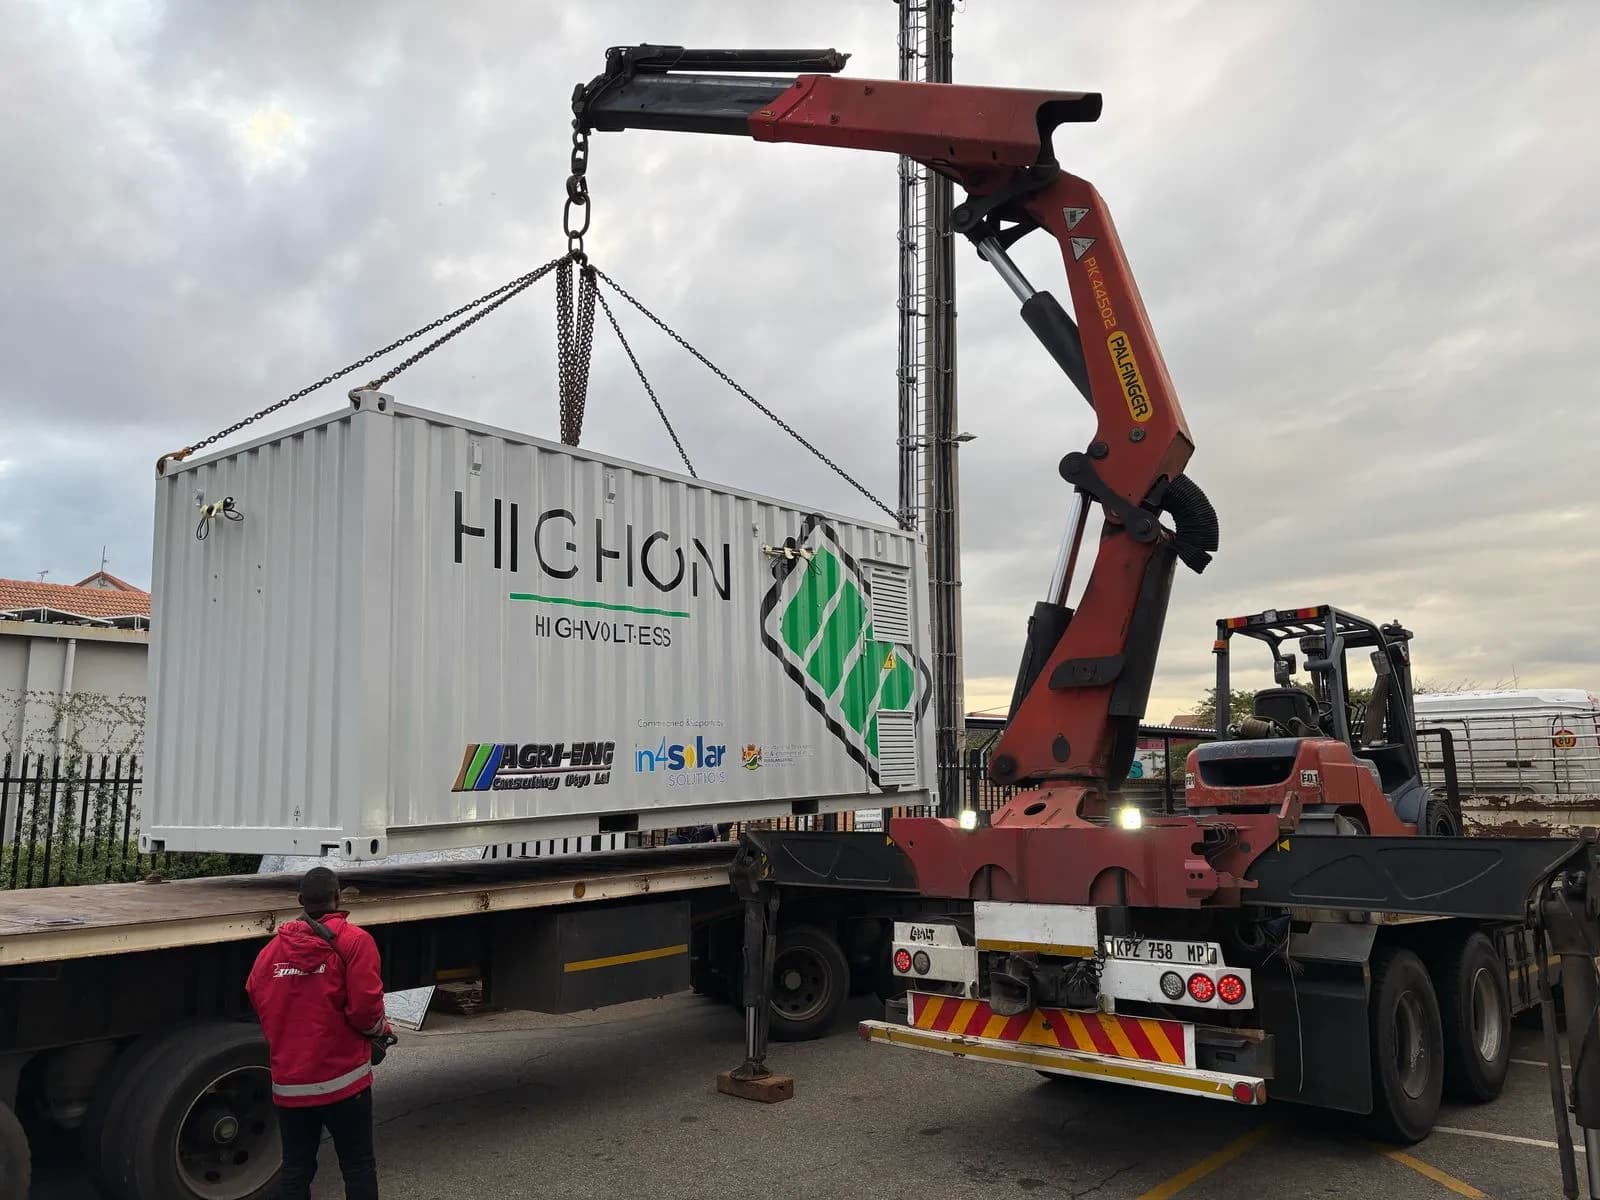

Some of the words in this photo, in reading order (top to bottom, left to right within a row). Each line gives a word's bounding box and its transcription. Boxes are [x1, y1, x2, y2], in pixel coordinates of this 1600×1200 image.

[1084, 256, 1101, 278] PK
[1092, 279, 1117, 329] 44502
[1110, 335, 1149, 418] PALFINGER
[454, 490, 731, 601] HIGHON
[668, 771, 727, 786] SOLUTIOS
[1116, 938, 1140, 958] KPZ
[1148, 942, 1173, 960] 758
[1187, 944, 1205, 962] MP
